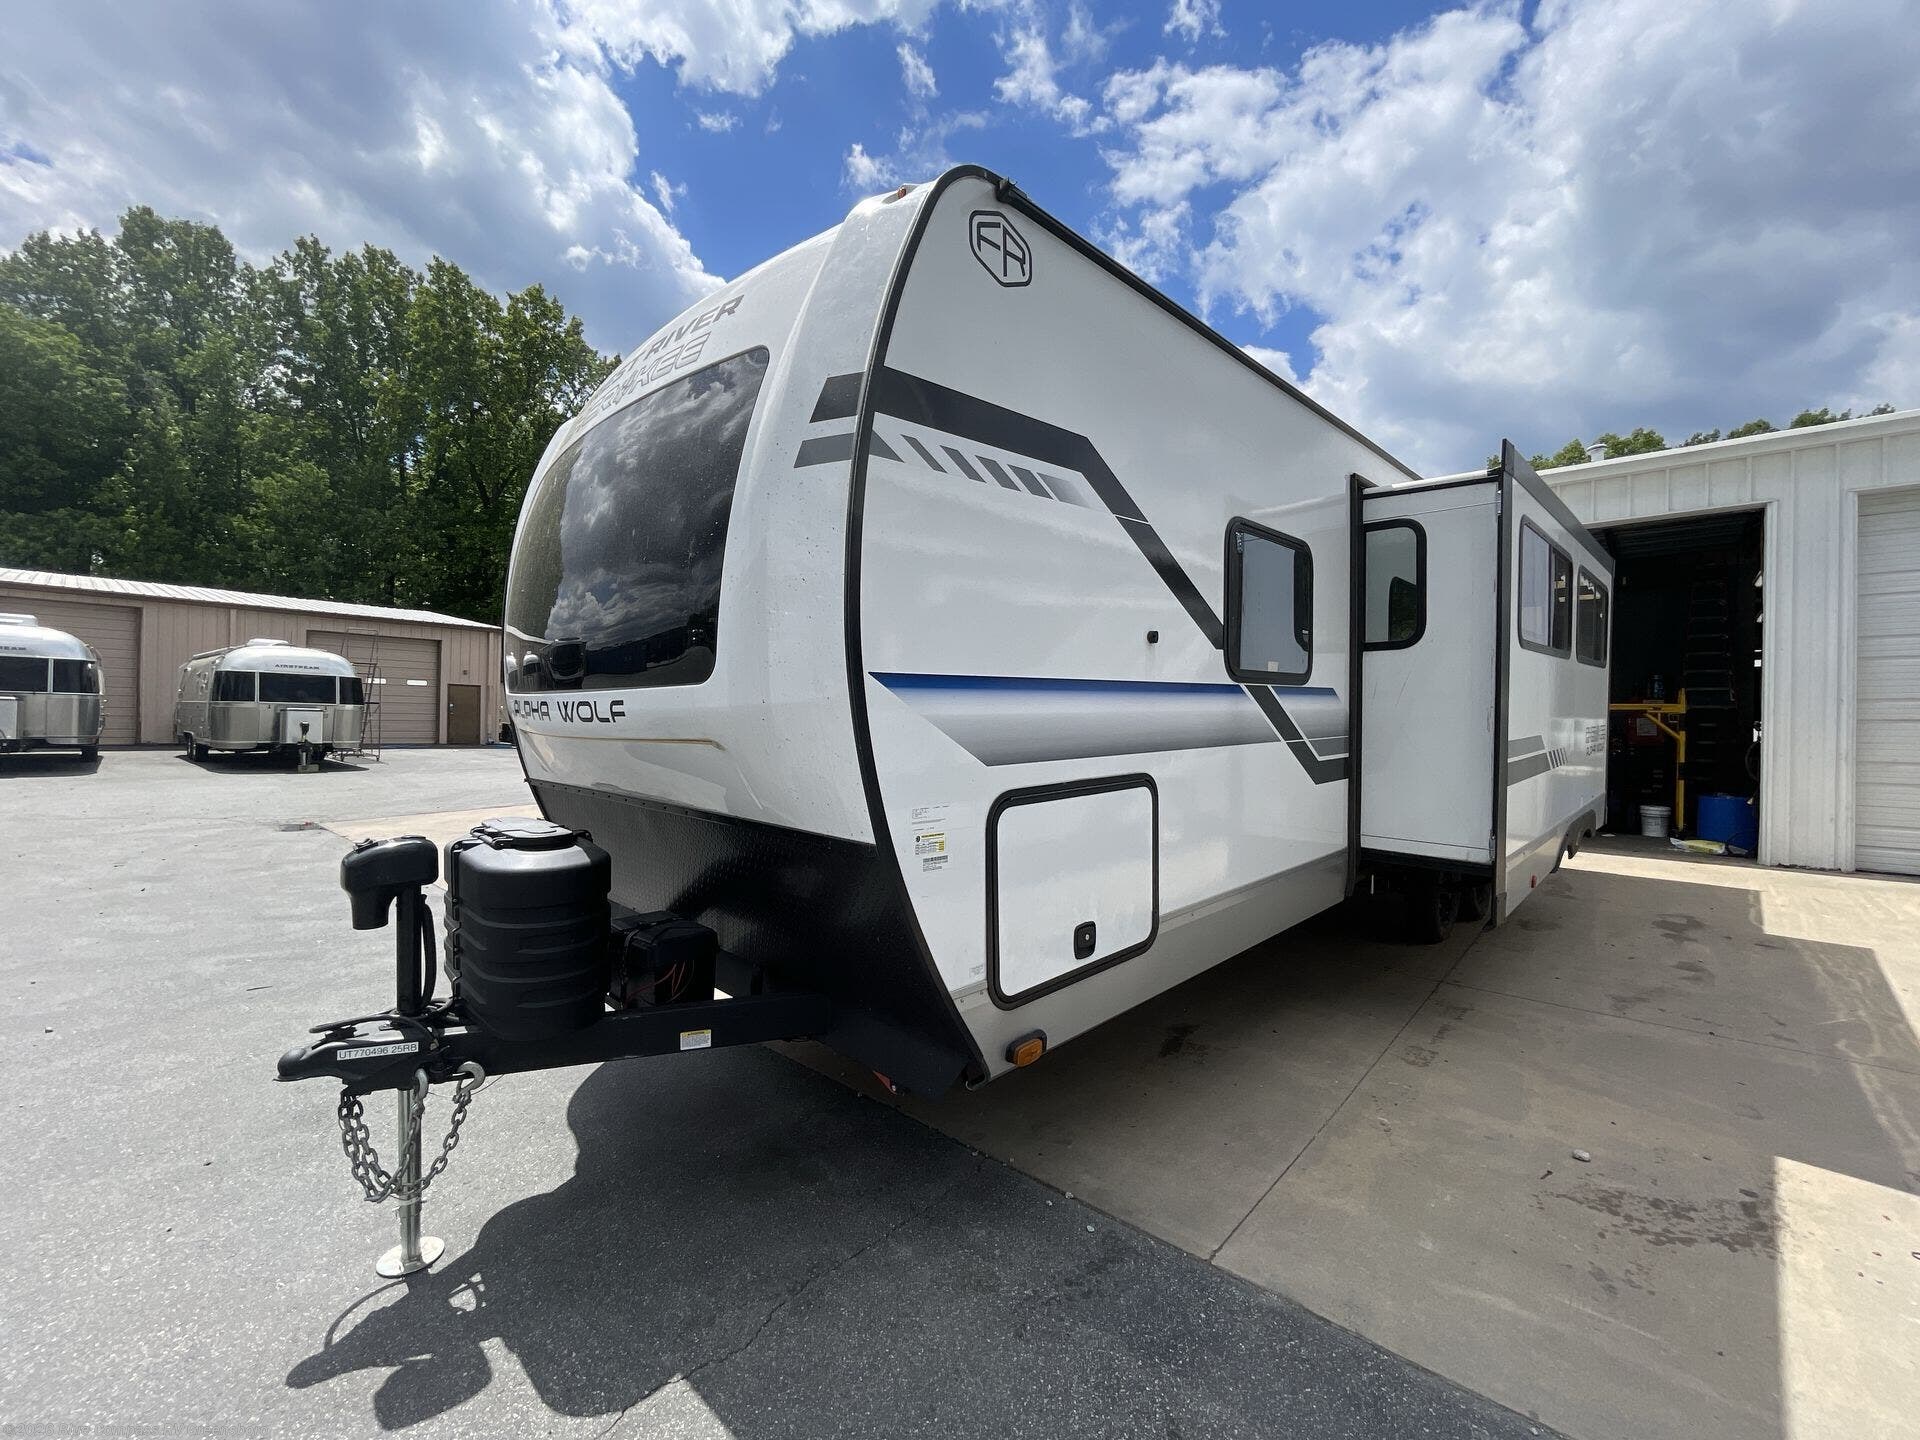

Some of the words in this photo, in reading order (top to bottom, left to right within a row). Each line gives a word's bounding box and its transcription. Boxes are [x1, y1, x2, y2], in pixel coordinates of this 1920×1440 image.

[643, 294, 745, 360] RIVER
[513, 700, 551, 721] ALPHA
[557, 699, 626, 722] WOLF
[338, 1046, 389, 1059] UT770496
[391, 1043, 418, 1054] 25RB
